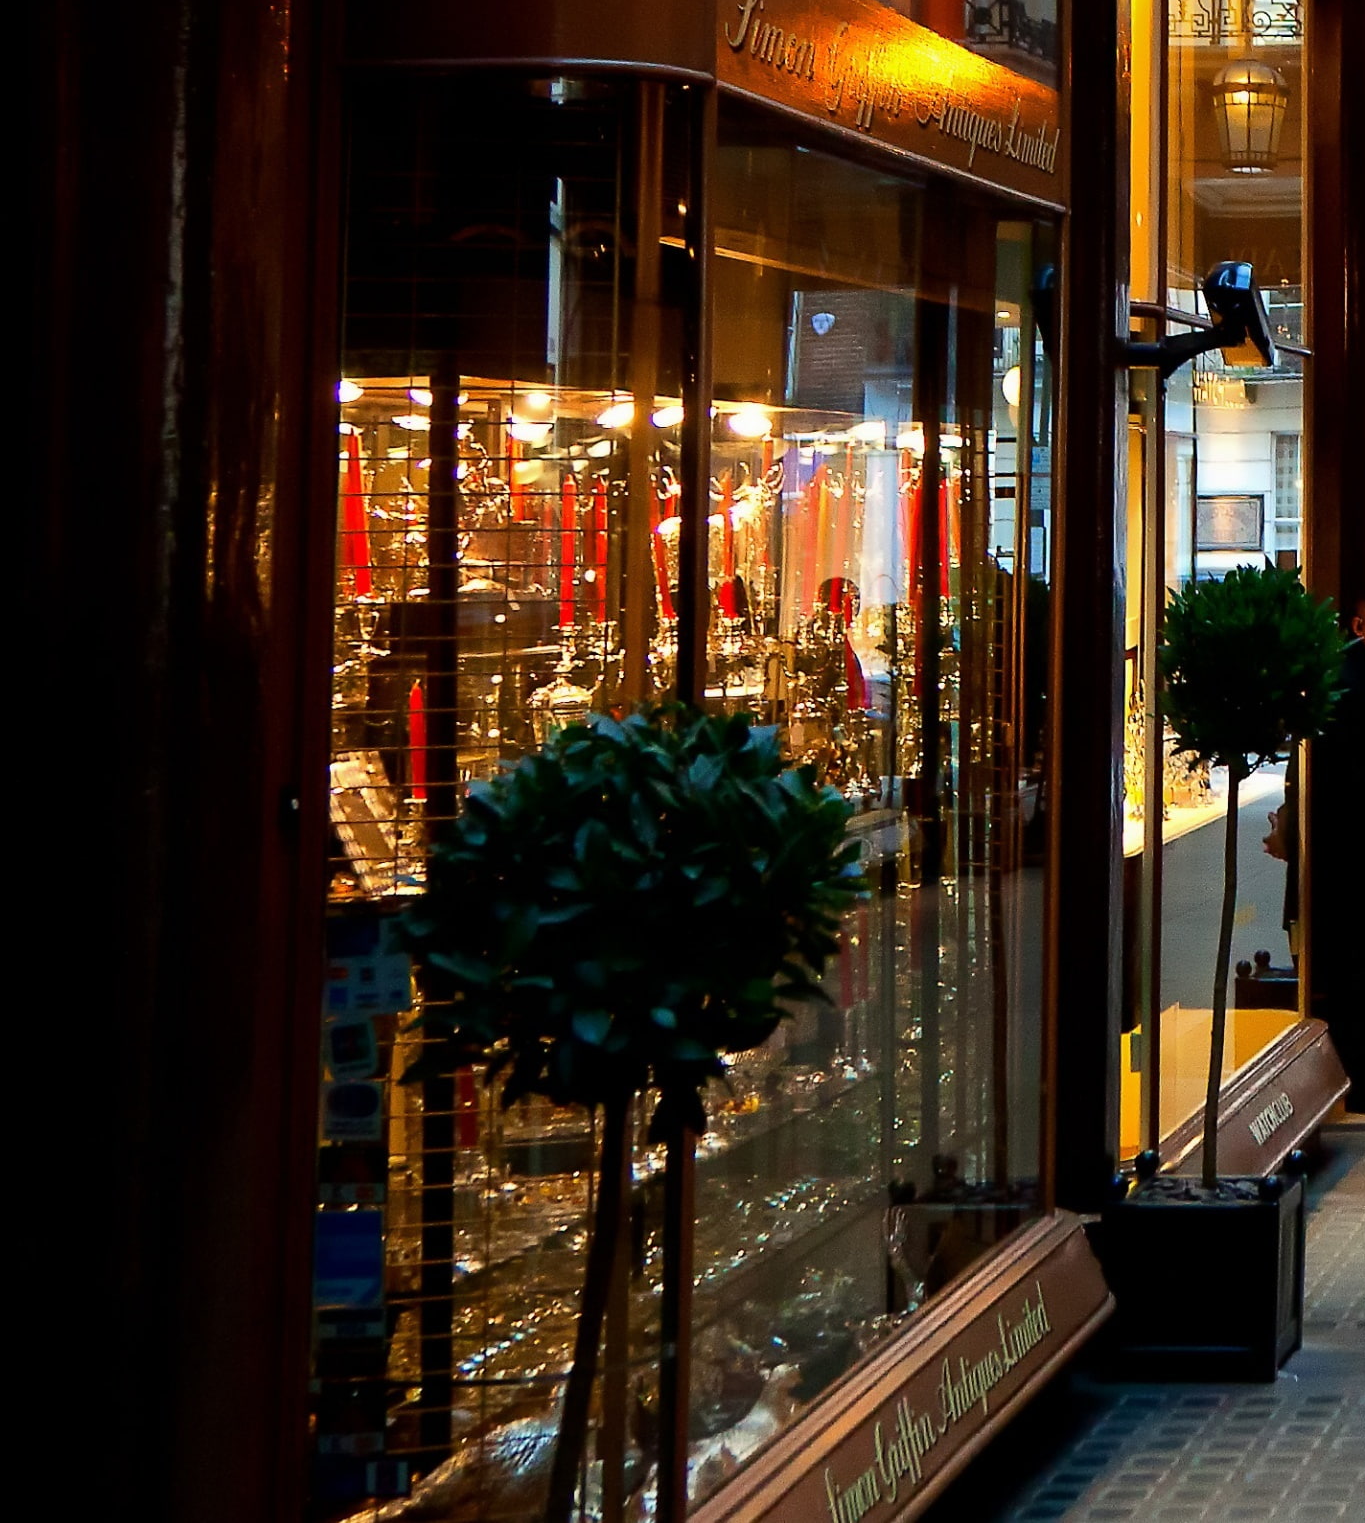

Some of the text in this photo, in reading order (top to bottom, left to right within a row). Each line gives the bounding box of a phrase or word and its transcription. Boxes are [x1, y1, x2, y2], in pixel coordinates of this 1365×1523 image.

[1003, 97, 1061, 175] Limited
[1247, 1091, 1294, 1146] WATCHCLUB
[873, 1395, 937, 1504] Griffin
[937, 1356, 1004, 1434] Antiques
[998, 1279, 1051, 1374] Limited
